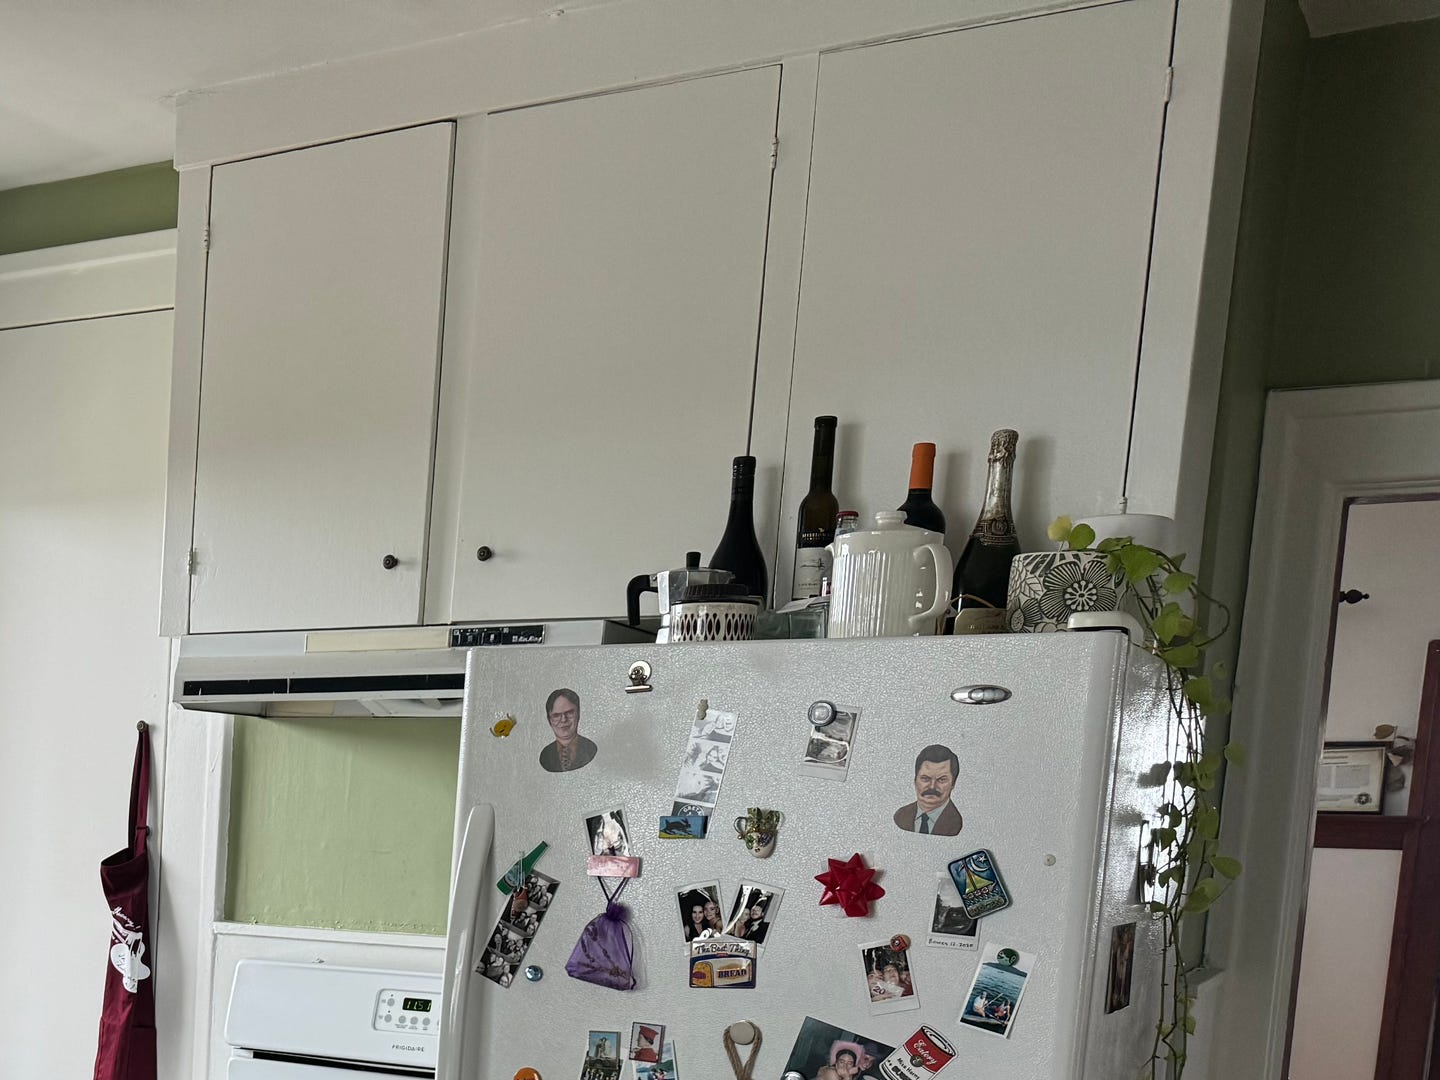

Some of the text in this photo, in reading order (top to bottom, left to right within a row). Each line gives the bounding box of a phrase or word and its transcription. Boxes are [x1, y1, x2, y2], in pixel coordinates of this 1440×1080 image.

[695, 944, 710, 954] The
[710, 943, 728, 953] Best
[729, 943, 750, 956] Thing
[718, 968, 747, 979] BREAD
[391, 1044, 425, 1053] FRIGIDAIRE
[913, 1039, 937, 1066] Eatery
